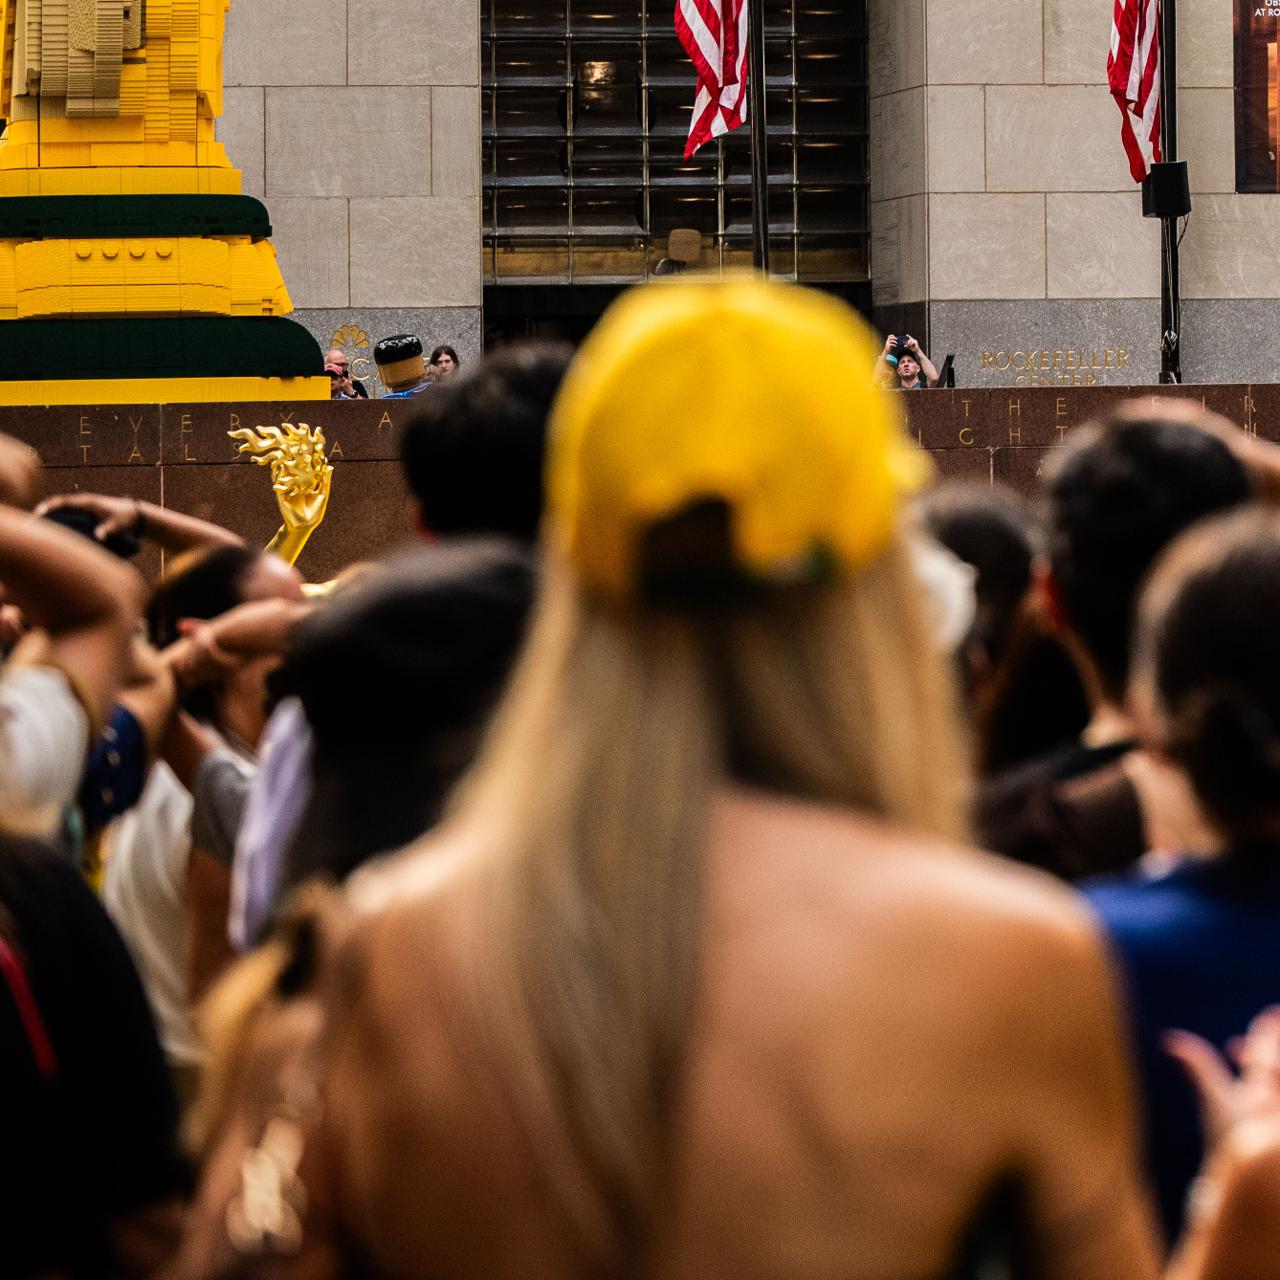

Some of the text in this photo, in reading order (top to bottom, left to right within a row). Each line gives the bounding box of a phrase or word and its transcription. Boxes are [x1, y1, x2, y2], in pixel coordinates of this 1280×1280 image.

[1254, 8, 1267, 17] AT
[981, 350, 1129, 370] ROCKEFELLER
[1014, 373, 1098, 386] CENTER
[961, 397, 1069, 417] THE
[917, 426, 1071, 446] IGHT
